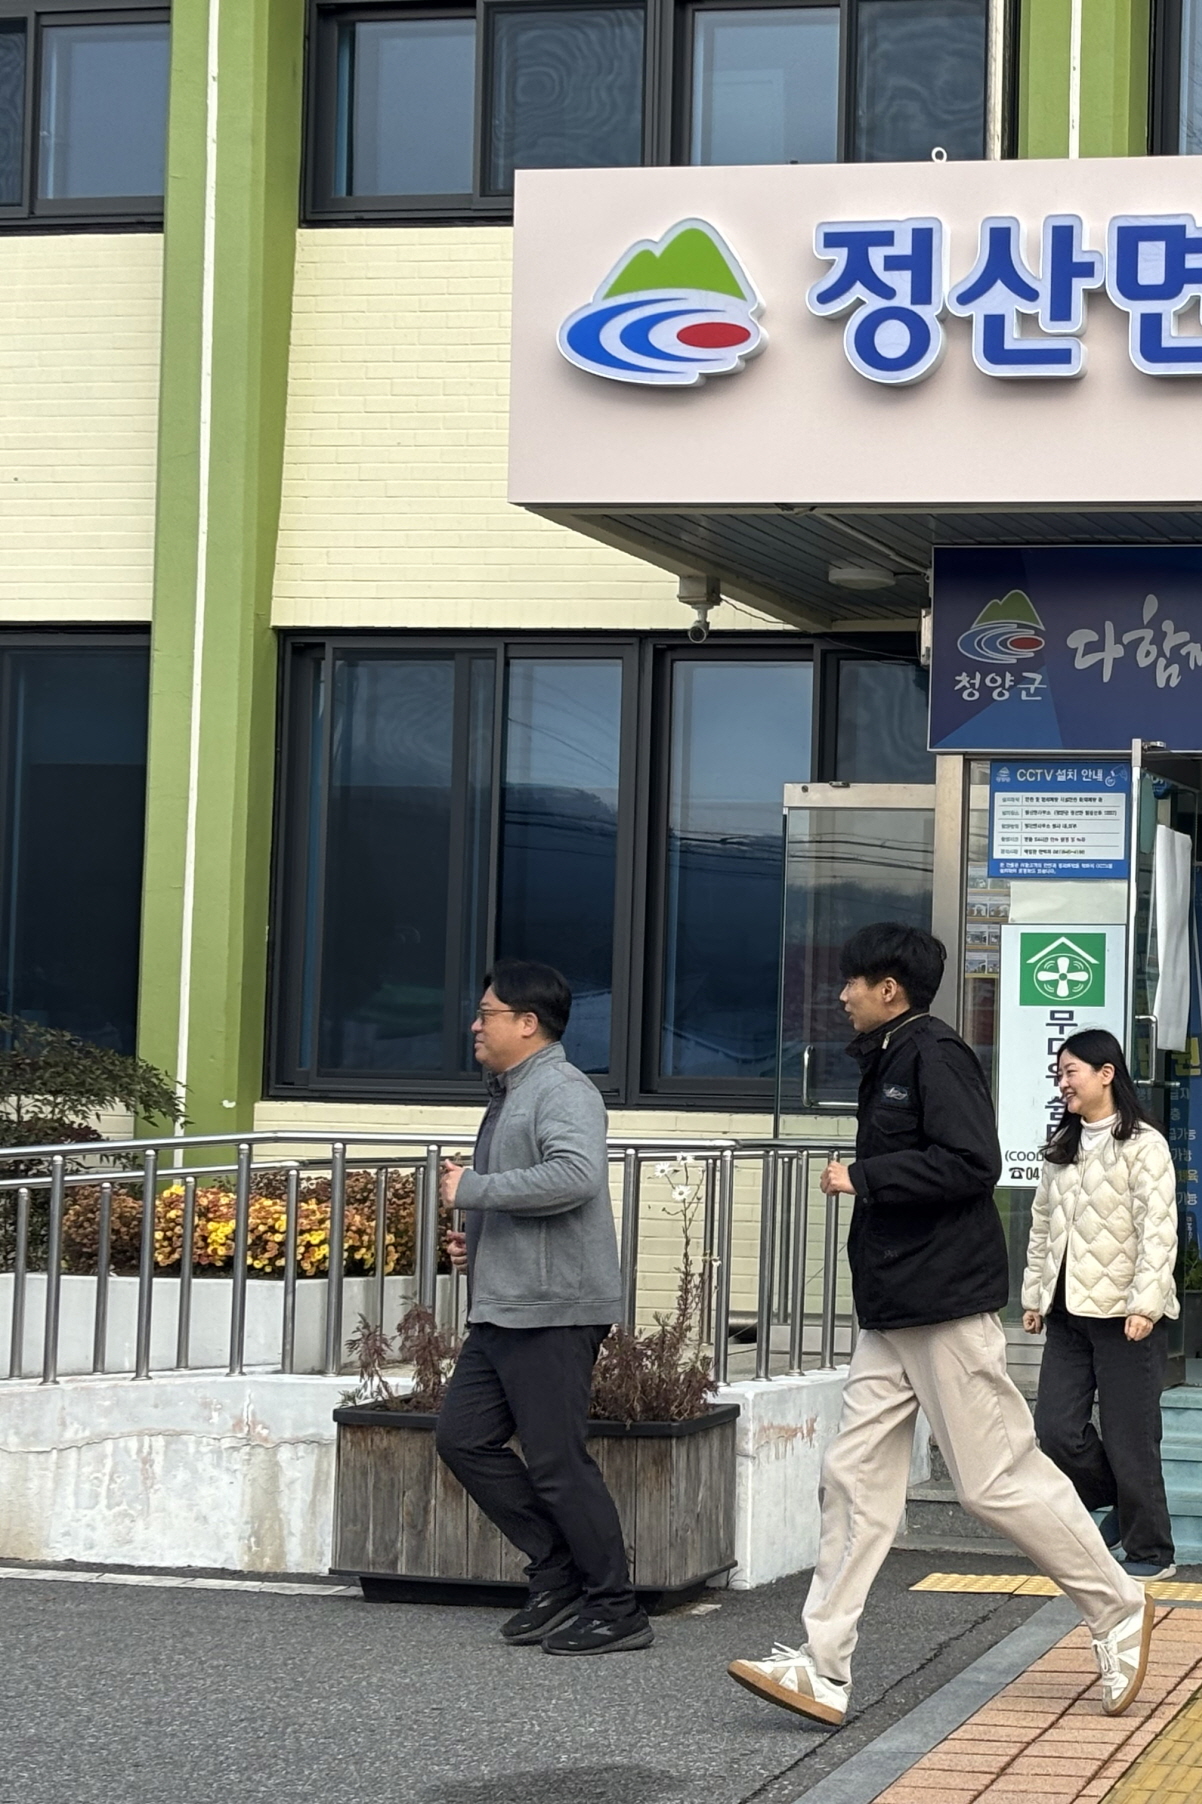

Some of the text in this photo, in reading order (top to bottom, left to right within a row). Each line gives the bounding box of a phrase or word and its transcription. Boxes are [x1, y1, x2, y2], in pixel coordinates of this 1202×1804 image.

[954, 671, 1047, 700] 청양군
[1016, 768, 1054, 782] CCTV
[1055, 768, 1077, 782] 설치
[1081, 768, 1103, 782] 안내
[1026, 1166, 1042, 1180] 04
